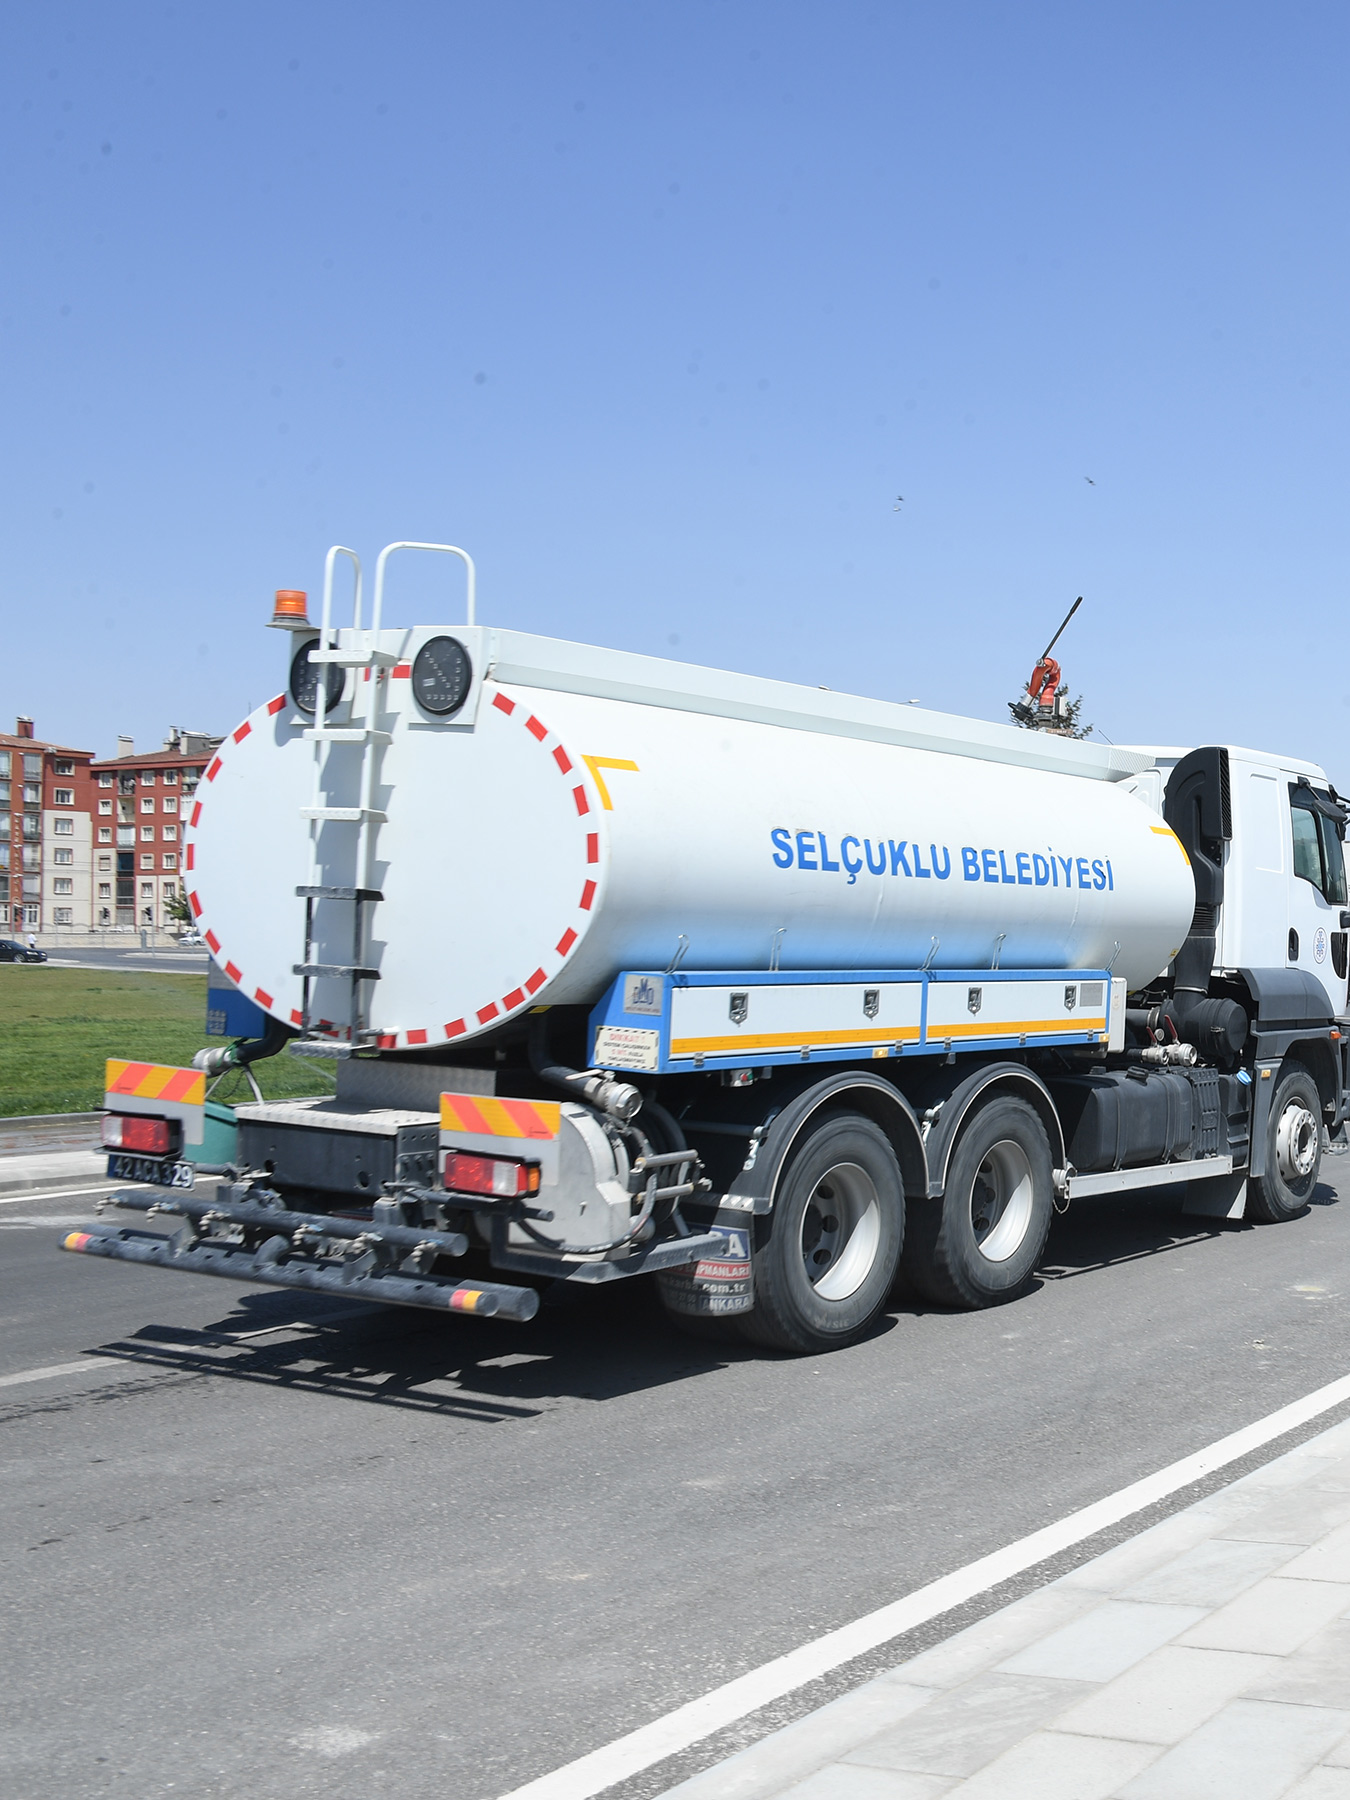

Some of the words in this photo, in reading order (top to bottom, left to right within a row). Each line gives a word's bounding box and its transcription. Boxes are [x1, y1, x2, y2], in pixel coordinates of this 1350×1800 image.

[771, 828, 951, 885] SELÇUKLU
[961, 846, 1114, 891] BELEDİYESİ
[113, 1156, 132, 1178] 42
[133, 1159, 160, 1184] ACA
[160, 1163, 193, 1188] 329
